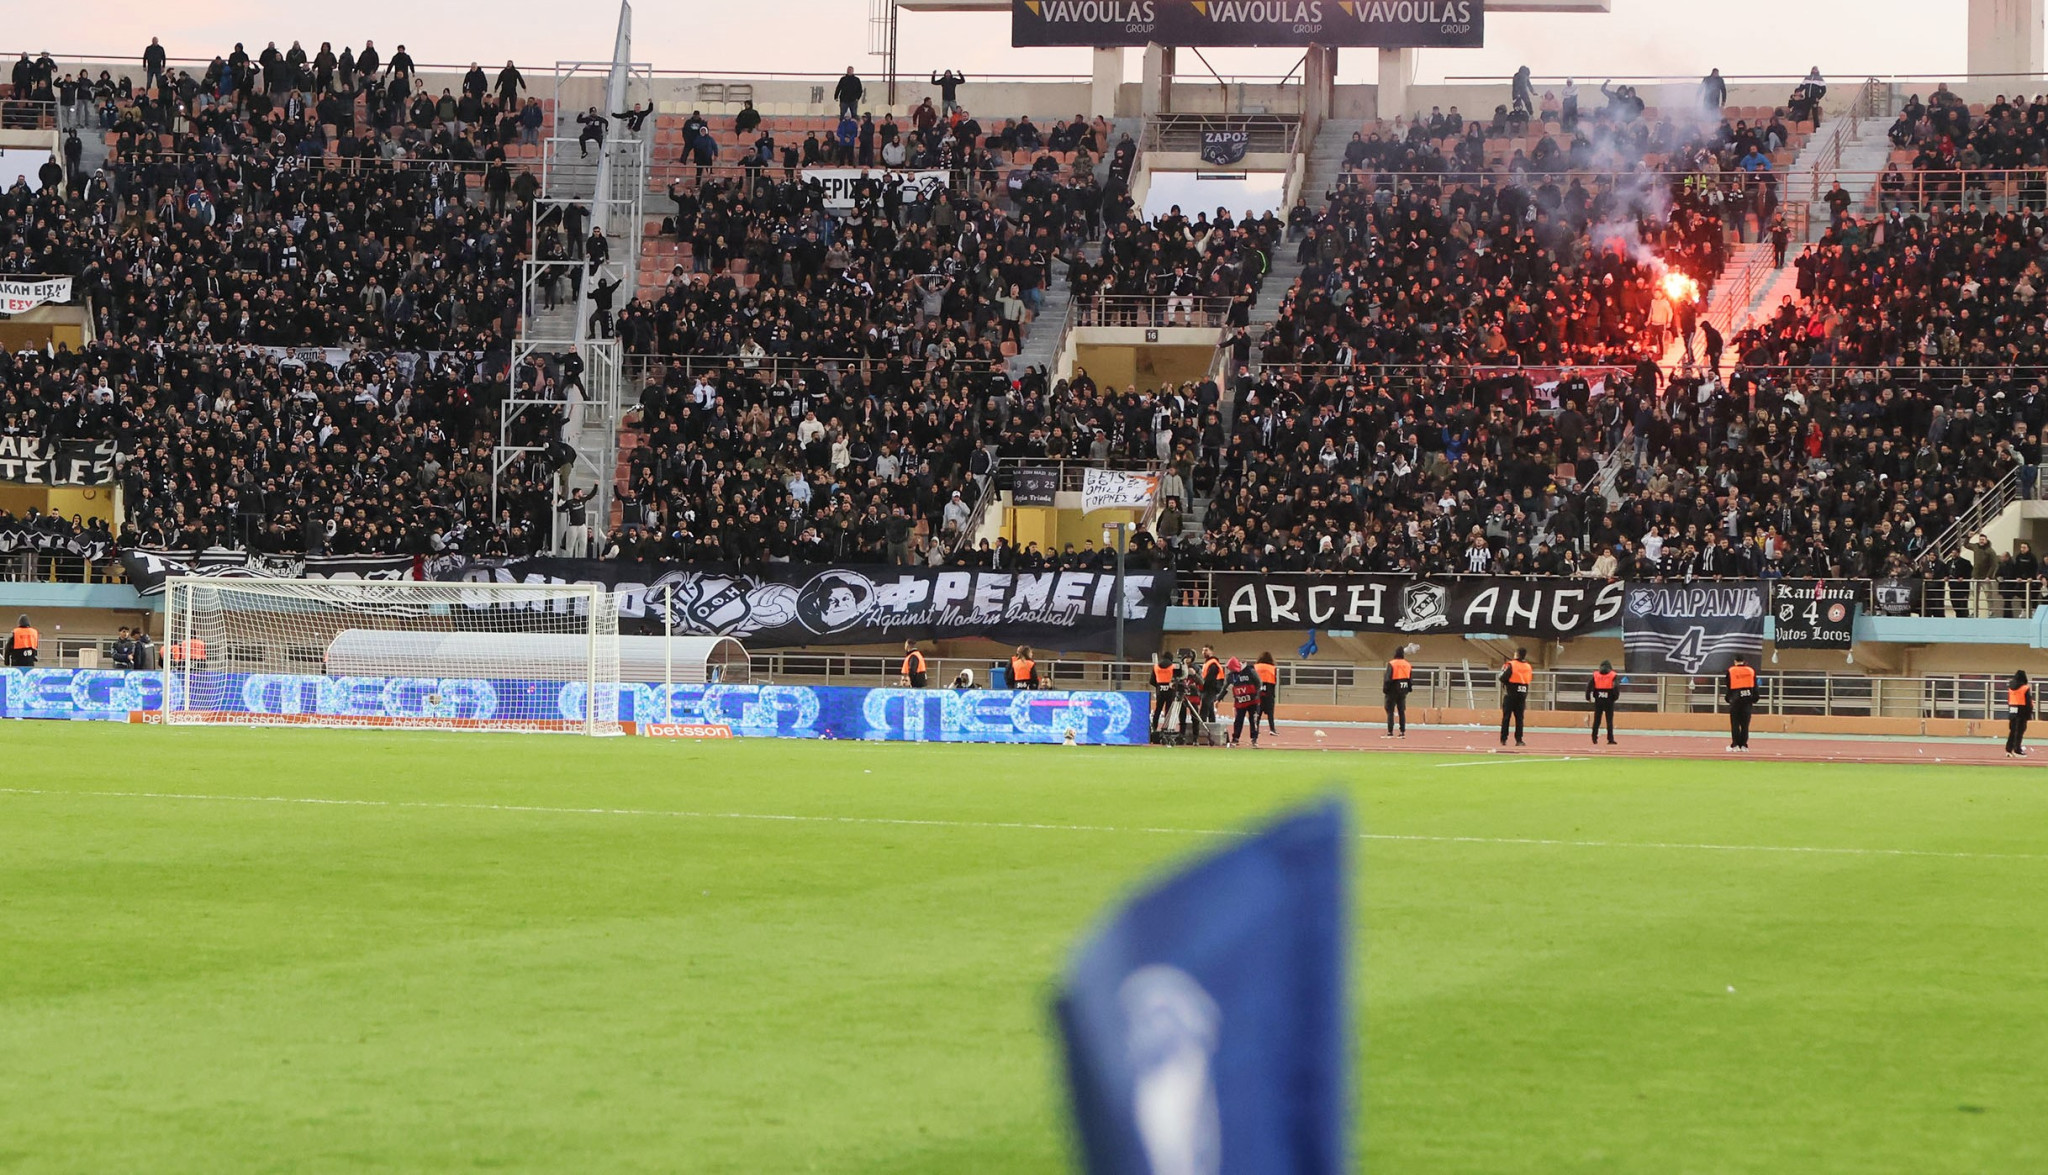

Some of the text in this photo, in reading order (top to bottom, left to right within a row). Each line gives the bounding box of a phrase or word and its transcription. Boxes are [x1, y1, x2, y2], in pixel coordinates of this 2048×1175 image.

[1041, 0, 1155, 22] VAVOULAS
[1206, 0, 1323, 23] VAVOULAS
[1354, 0, 1470, 23] VAVOULAS
[1125, 23, 1155, 34] GROUP
[1292, 23, 1323, 34] GROUP
[1440, 24, 1470, 35] GROUP
[1205, 132, 1249, 143] ΖΑΡΟΣ
[1147, 332, 1157, 340] 16
[1044, 480, 1055, 489] 25
[1228, 583, 1388, 624] ARCH
[1802, 600, 1820, 626] 4
[866, 602, 1079, 635] Against Modern Football
[1811, 626, 1851, 642] Locos
[1665, 625, 1709, 674] 4
[242, 673, 497, 719] MEGA
[558, 681, 820, 730] MEGA
[863, 687, 1132, 734] MEGA
[649, 724, 729, 738] betsson
